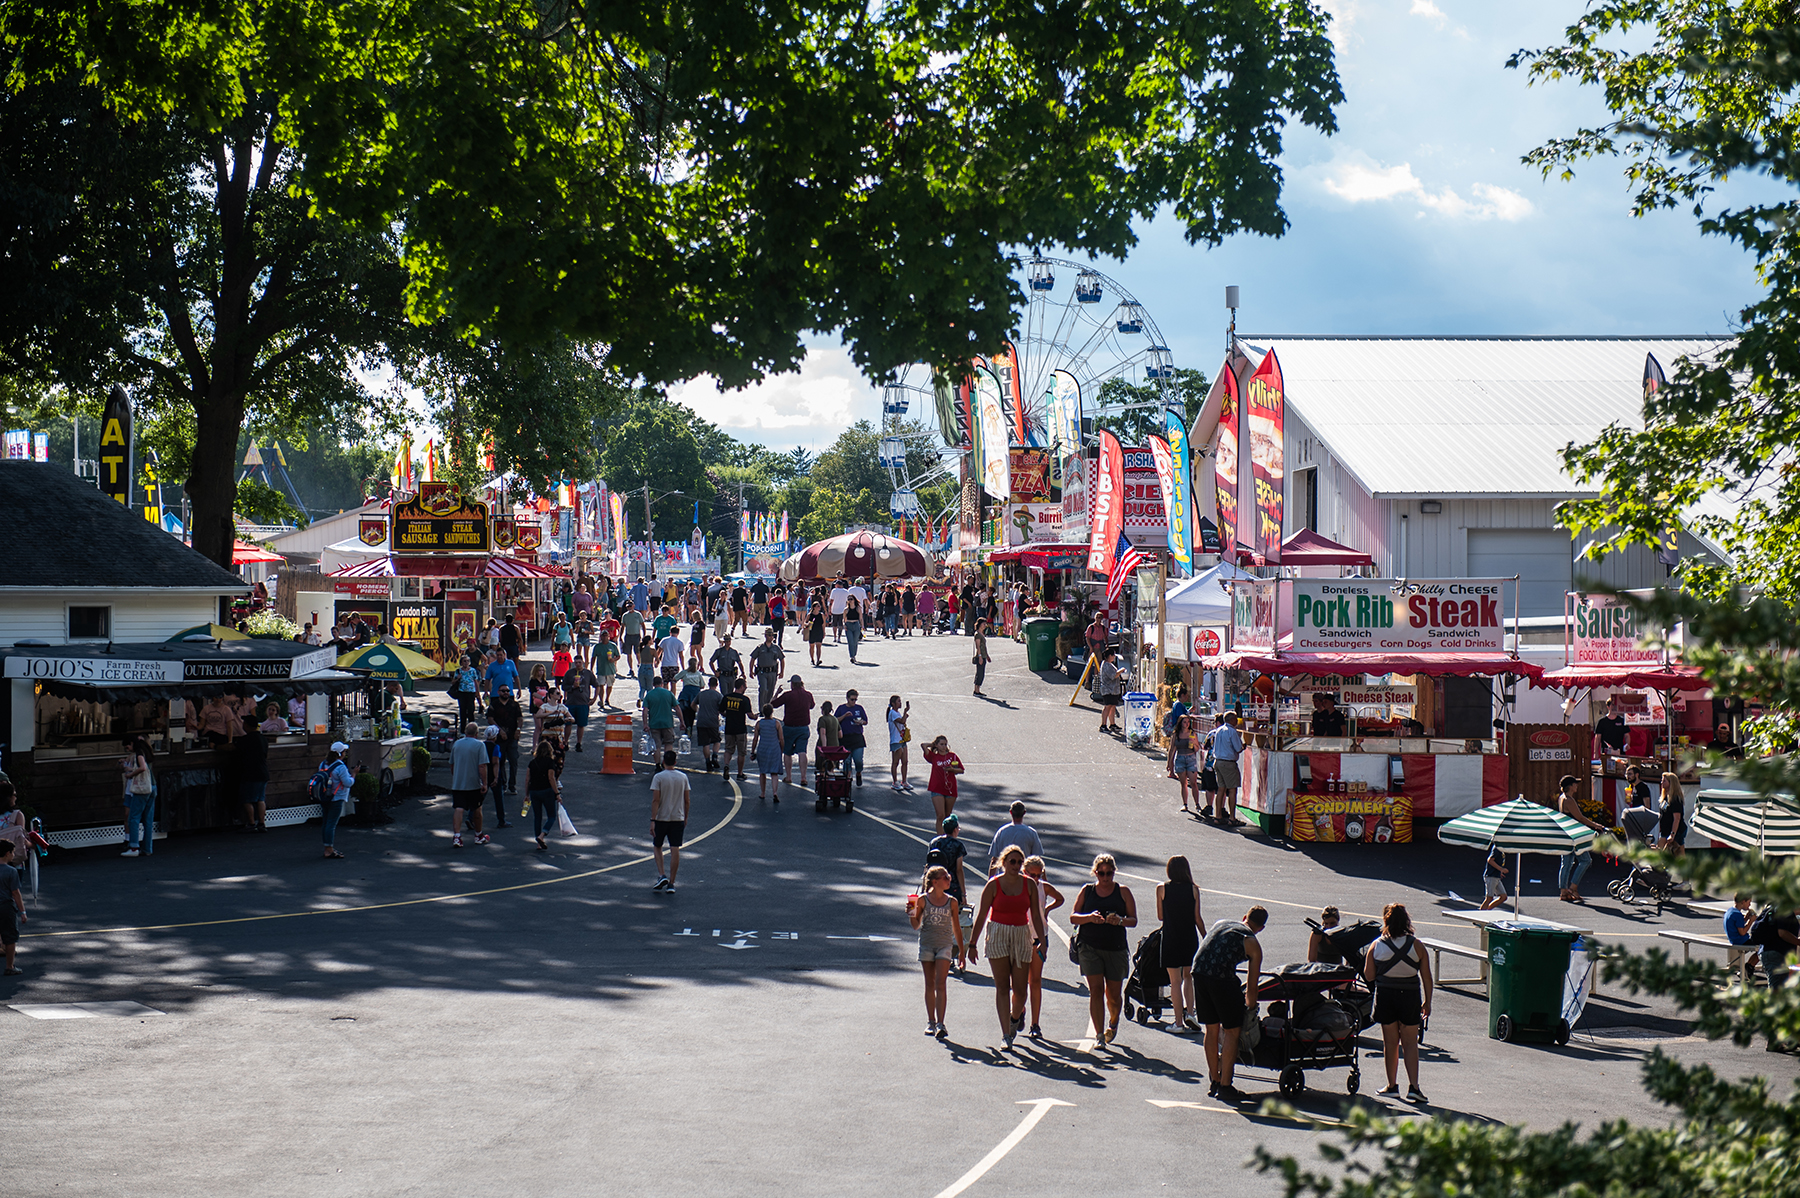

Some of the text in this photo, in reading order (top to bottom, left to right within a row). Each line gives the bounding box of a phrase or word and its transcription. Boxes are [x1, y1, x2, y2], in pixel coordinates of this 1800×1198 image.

[1010, 472, 1051, 496] ZZA!
[1089, 432, 1114, 571] LOBSTER
[1125, 502, 1166, 517] OUGH
[1038, 512, 1062, 523] Burrit
[408, 524, 432, 533] ITALIAN
[452, 524, 473, 532] STEAK
[401, 533, 438, 544] SAUSAGE
[444, 533, 480, 544] SANDWICHES
[746, 543, 783, 554] POPCORN!
[1322, 585, 1369, 594] Boneless
[1449, 584, 1498, 594] Cheese
[396, 606, 437, 617] London Broil
[1298, 594, 1394, 628] Pork Rib
[1408, 594, 1499, 628] Steak
[1577, 602, 1643, 641] Sausa
[393, 617, 440, 639] STEAK
[1319, 629, 1372, 638] Sandwich
[1428, 629, 1480, 638] Sandwich
[1300, 639, 1497, 649] Cheeseburgers Corn Dogs Cold Drinks
[23, 659, 94, 678] JOJO'S
[106, 661, 161, 670] Farm Fresh
[185, 664, 290, 676] OUTRAGEOUS SHAKES
[101, 670, 165, 680] ICE CREAM
[1343, 691, 1414, 703] Cheese Steak
[1530, 750, 1570, 760] let's eat
[1305, 801, 1404, 817] CONDIMENTS
